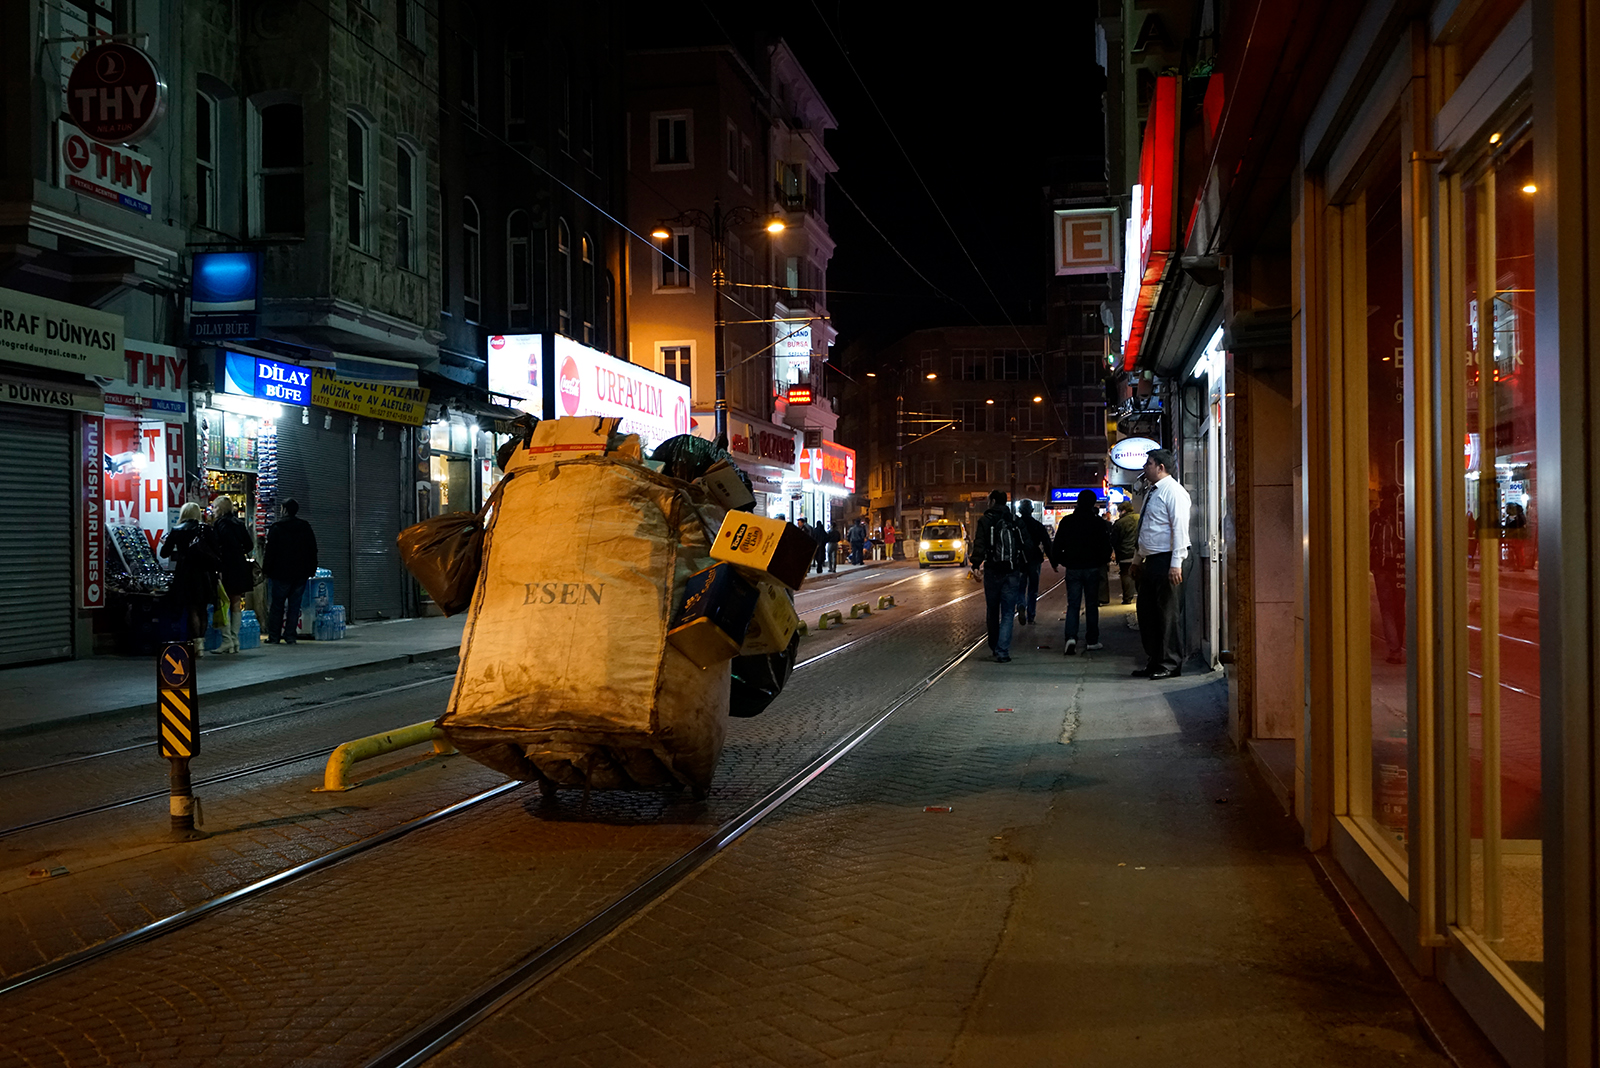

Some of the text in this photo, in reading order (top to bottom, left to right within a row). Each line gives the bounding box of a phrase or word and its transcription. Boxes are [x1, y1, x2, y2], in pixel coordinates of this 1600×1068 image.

[74, 84, 149, 122] THY
[93, 143, 153, 193] THY
[1072, 221, 1102, 260] E
[46, 318, 116, 351] DÜNYASI
[196, 320, 250, 335] DİLAY BÜFE
[124, 350, 187, 391] THY
[258, 364, 310, 387] DİLAY
[9, 383, 74, 406] DÜNYASI
[170, 403, 182, 411] TUR
[266, 383, 302, 401] BÜFE
[320, 383, 414, 413] MÜZİK ve AV ALETLERİ
[594, 365, 663, 418] URFA'LIM
[88, 421, 98, 497] TURKISH
[167, 427, 184, 505] THY
[88, 503, 99, 581] AIRLINES
[731, 525, 746, 548] Torku
[523, 583, 606, 605] ESEN
